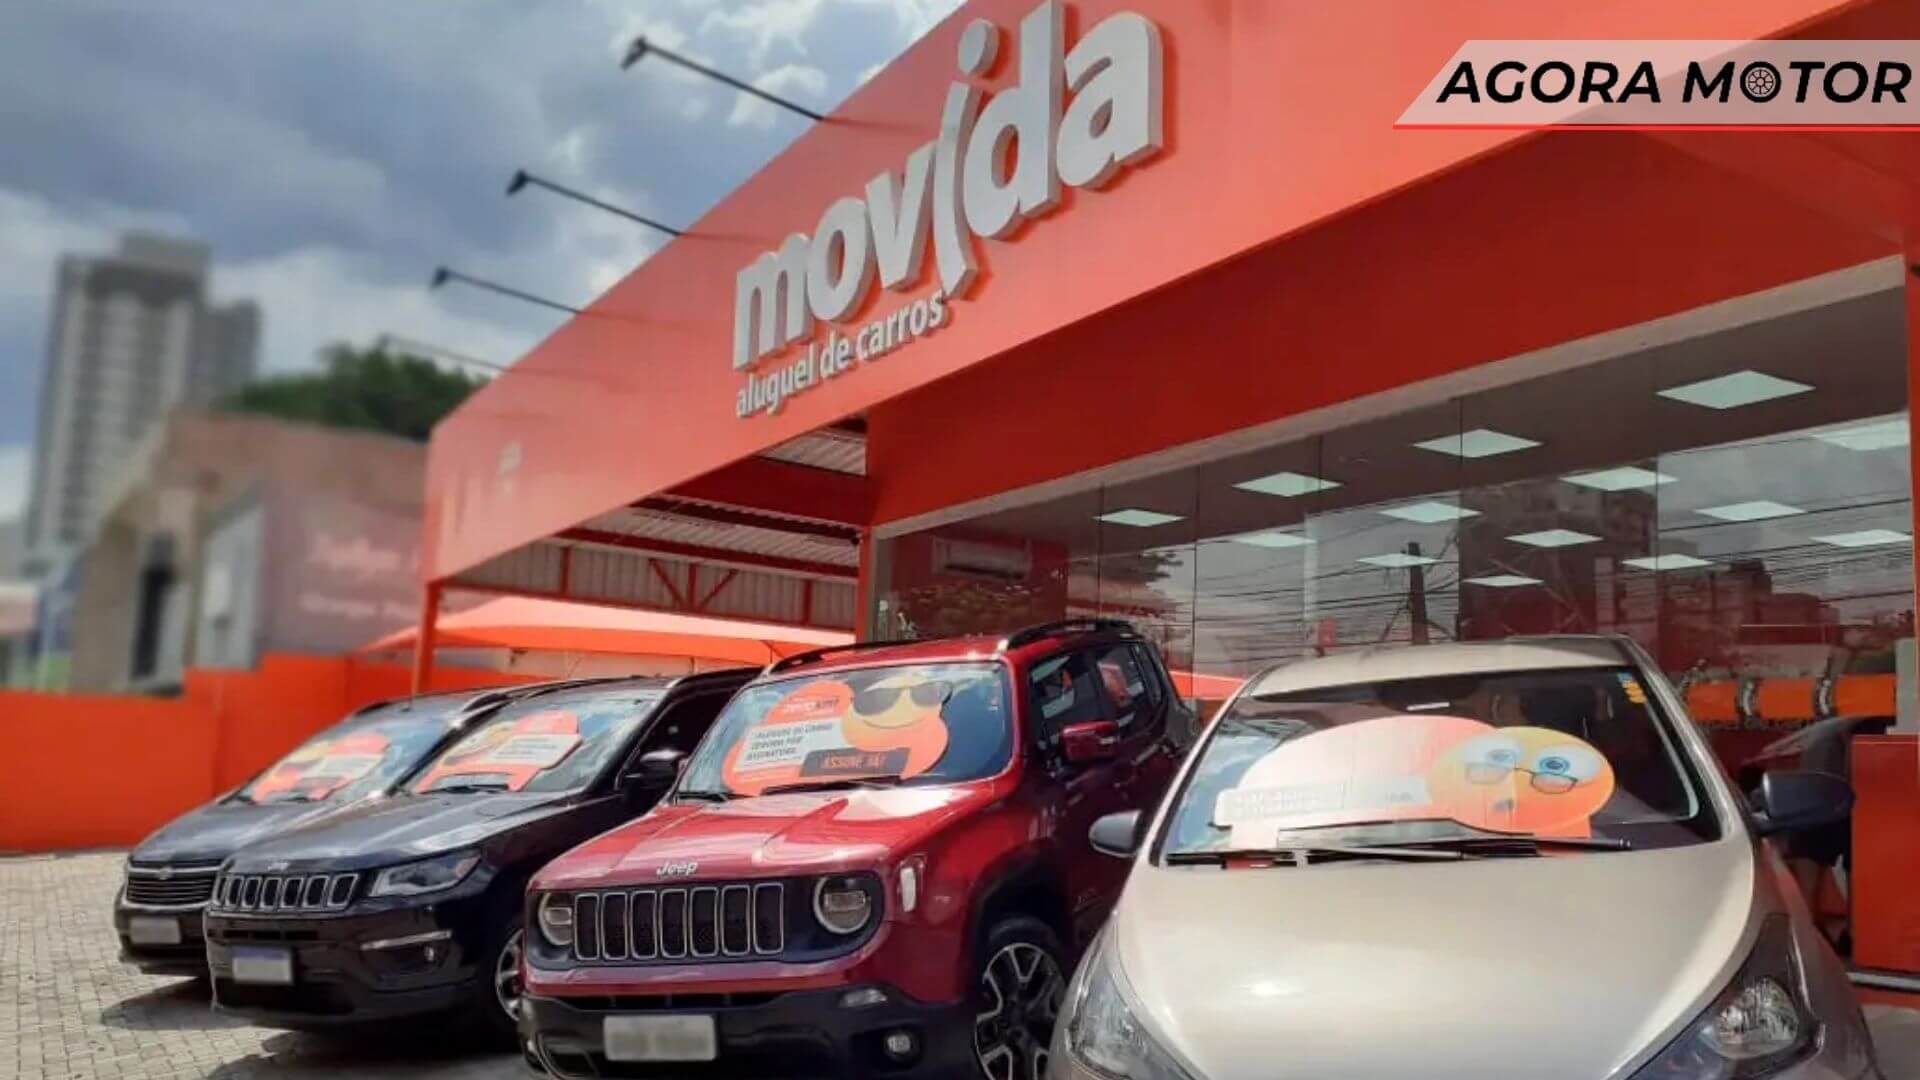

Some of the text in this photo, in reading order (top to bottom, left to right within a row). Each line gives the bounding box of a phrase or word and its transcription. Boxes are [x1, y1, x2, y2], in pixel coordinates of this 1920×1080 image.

[732, 0, 1164, 370] movida
[736, 293, 945, 418] aluguel de carros
[655, 861, 699, 877] Jeep
